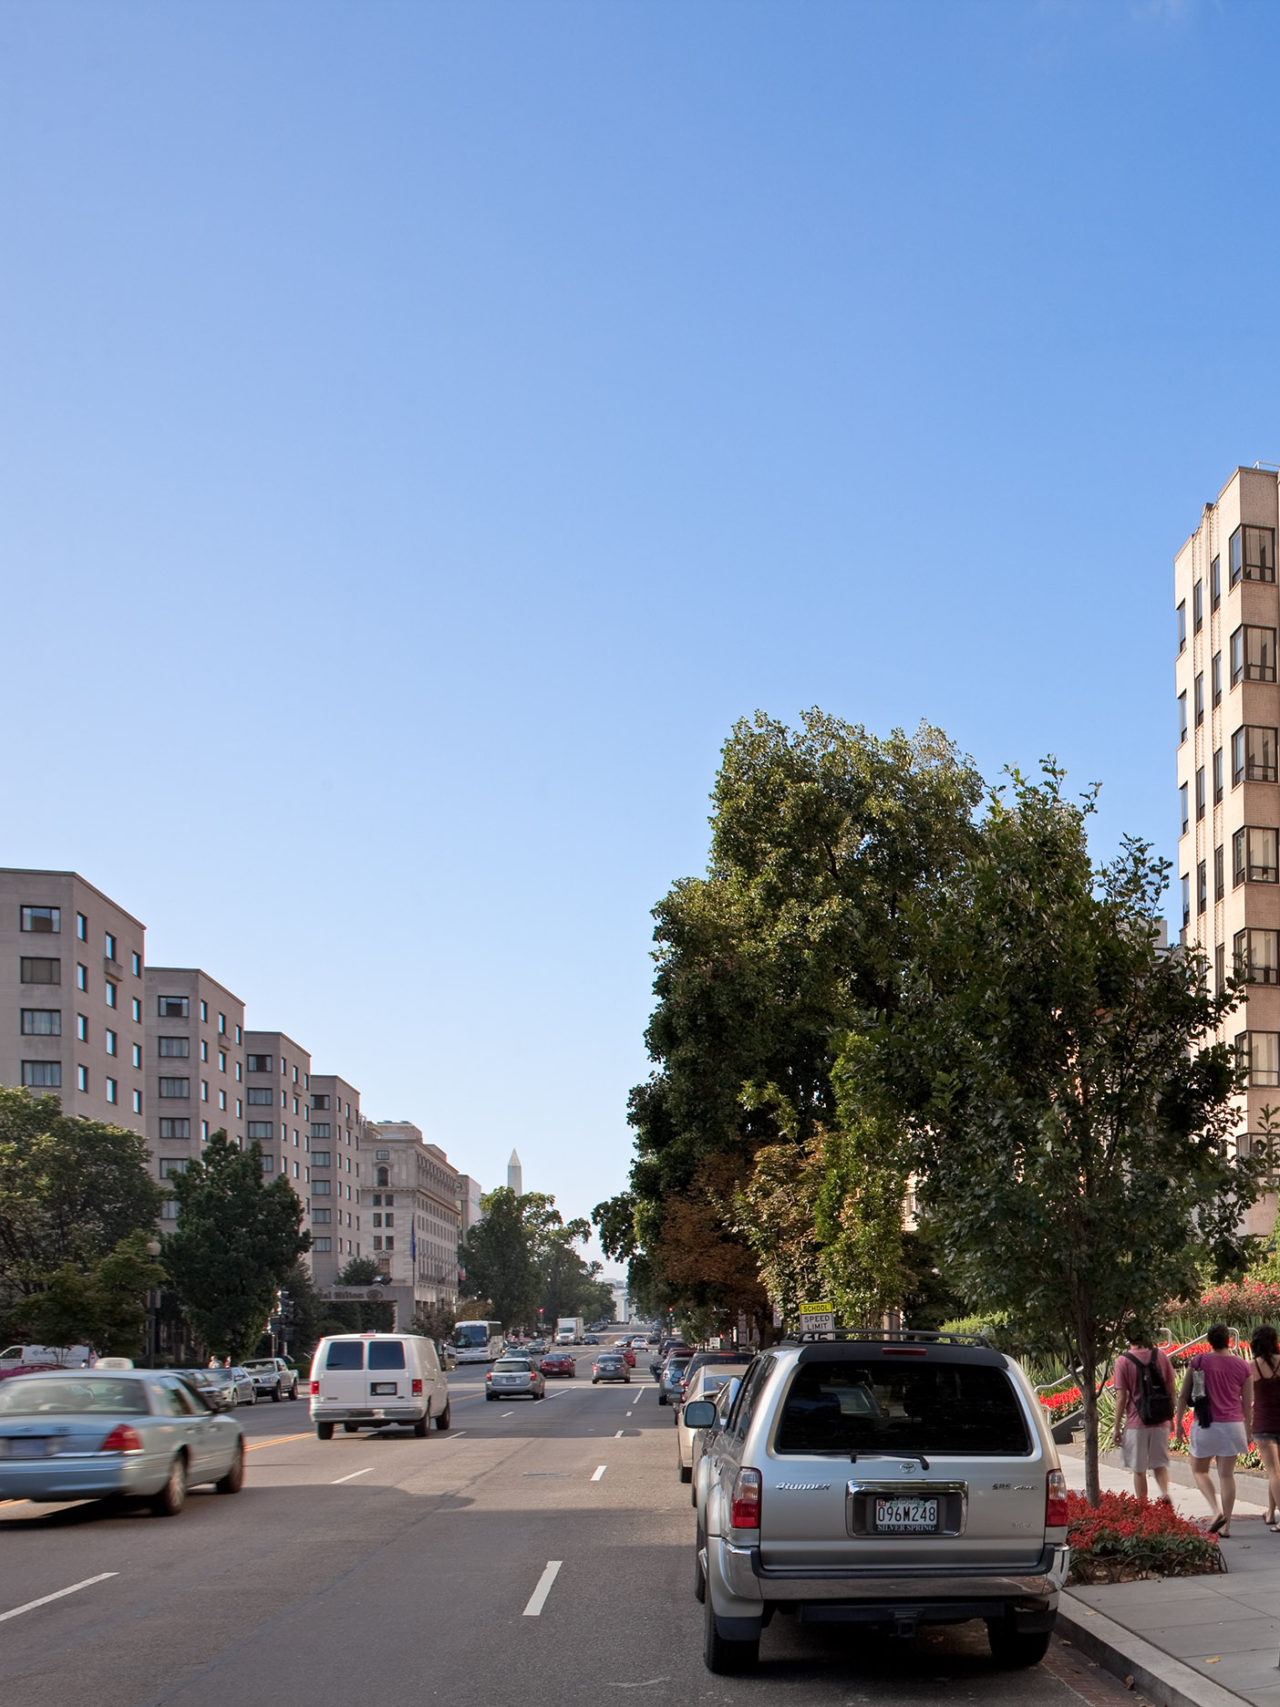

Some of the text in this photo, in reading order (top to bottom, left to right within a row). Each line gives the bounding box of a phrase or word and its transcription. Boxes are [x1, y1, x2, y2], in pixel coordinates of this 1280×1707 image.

[803, 1304, 829, 1312] SCHOOL
[804, 1315, 830, 1323] SPEED
[877, 1505, 936, 1522] 096M248
